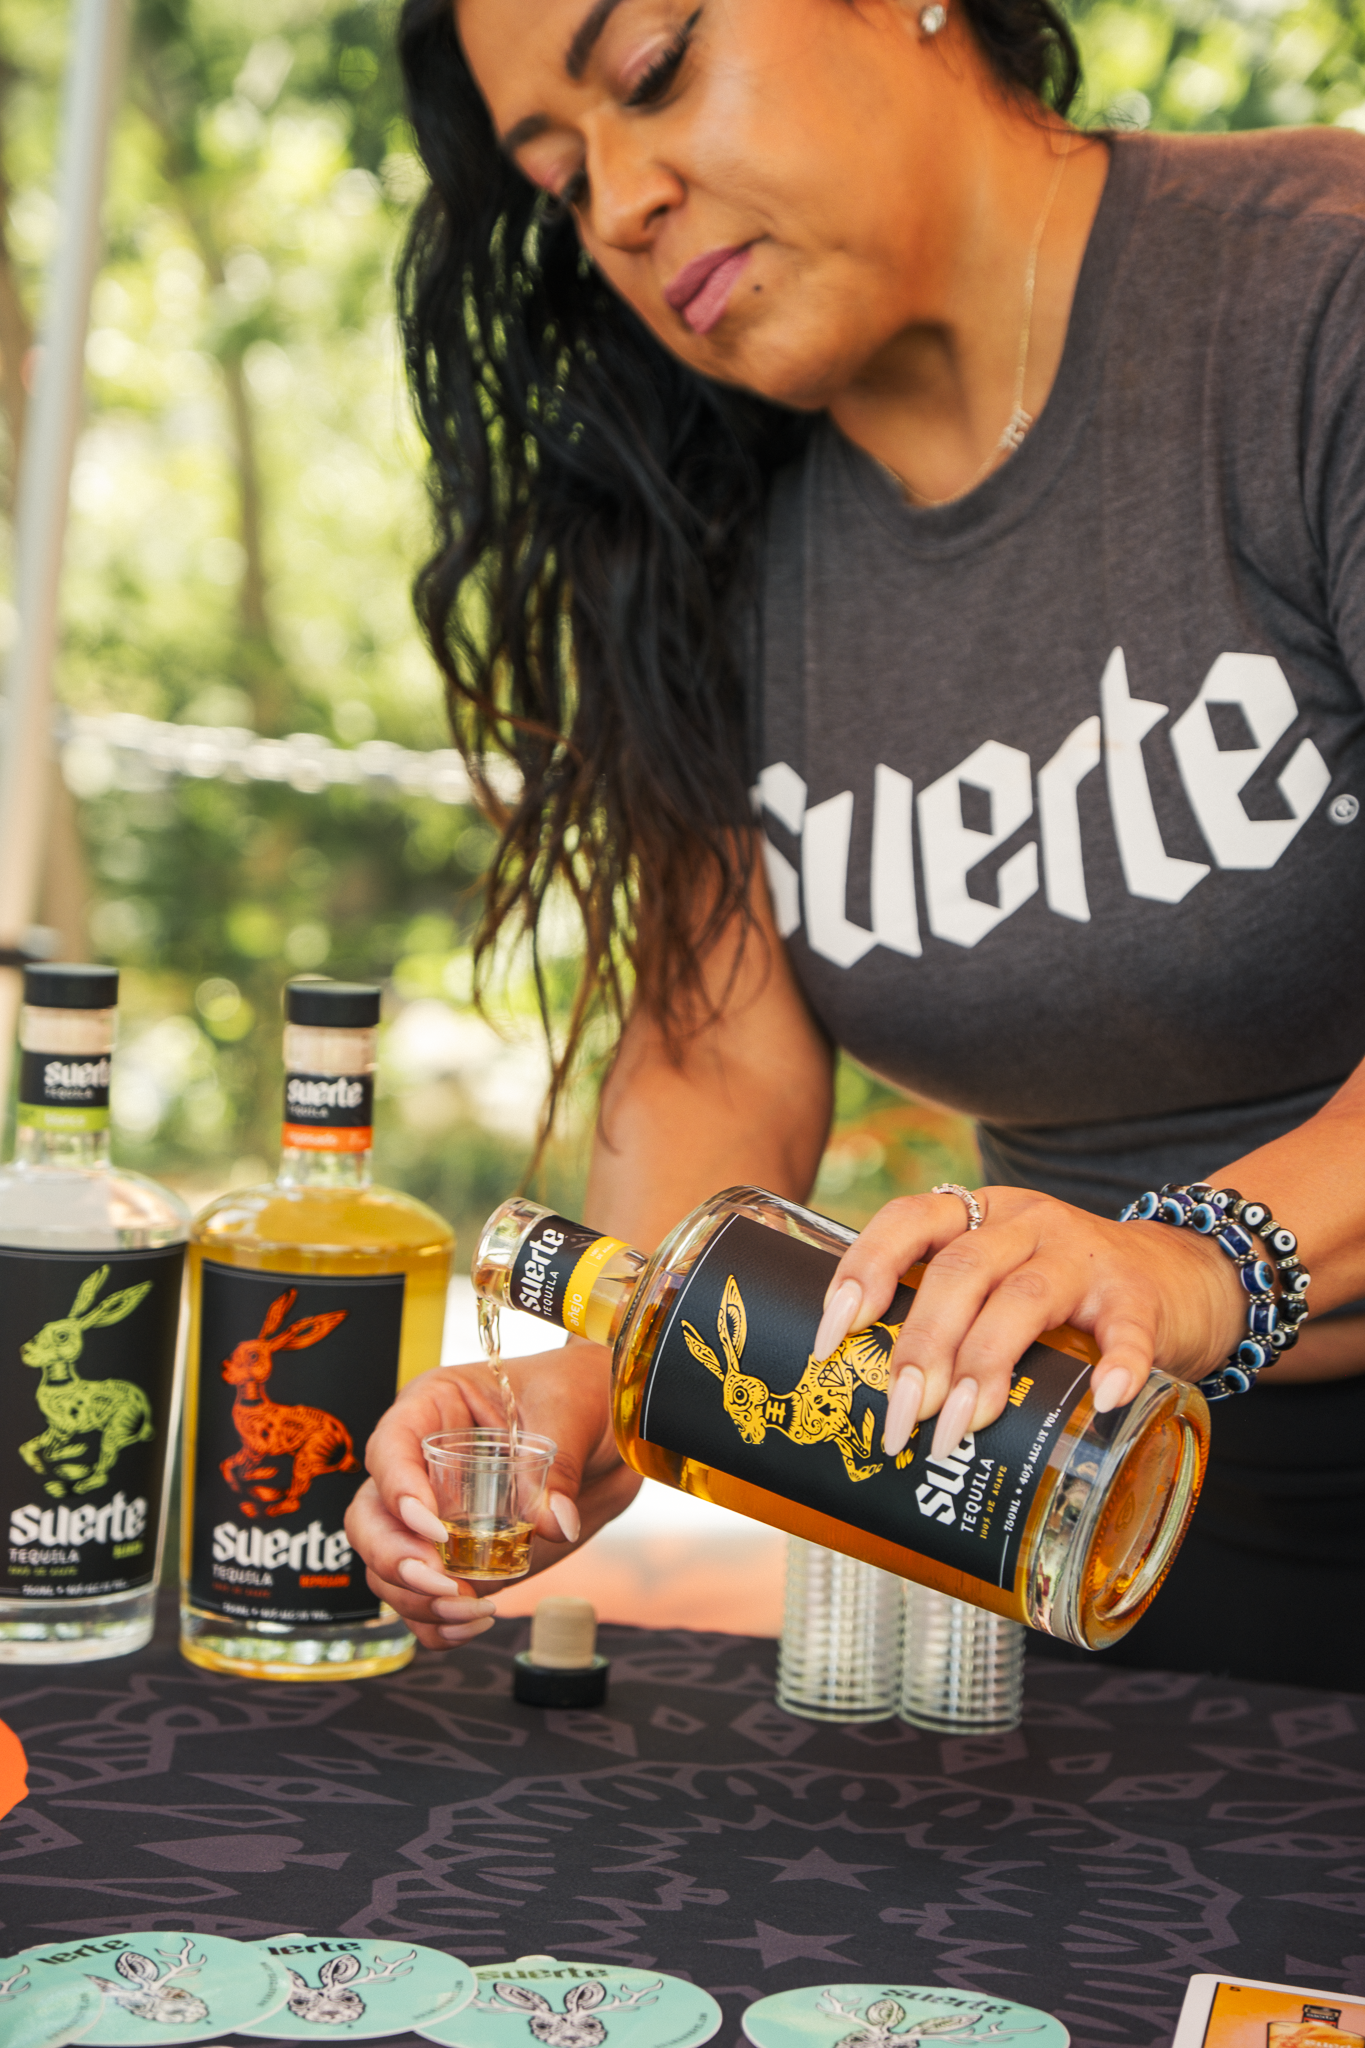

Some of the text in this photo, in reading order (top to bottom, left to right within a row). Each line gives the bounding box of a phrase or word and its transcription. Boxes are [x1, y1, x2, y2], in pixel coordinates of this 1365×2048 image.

[287, 1077, 363, 1108] suerte
[519, 1229, 564, 1312] suerte
[543, 1271, 559, 1317] TEQUILA
[1008, 1376, 1034, 1407] AÑEJO
[1003, 1499, 1021, 1532] 750ML
[1019, 1463, 1034, 1485] 40%
[1028, 1442, 1043, 1464] ALC
[1043, 1407, 1062, 1428] VOL.
[9, 1491, 147, 1547] suerte
[960, 1459, 995, 1532] TEQUILA
[980, 1465, 1008, 1539] 100% DE AGAVE
[8, 1548, 80, 1566] TEQUILA
[212, 1520, 352, 1572] suerte
[212, 1564, 274, 1587] TEQUILA
[475, 1967, 607, 1980] suerte
